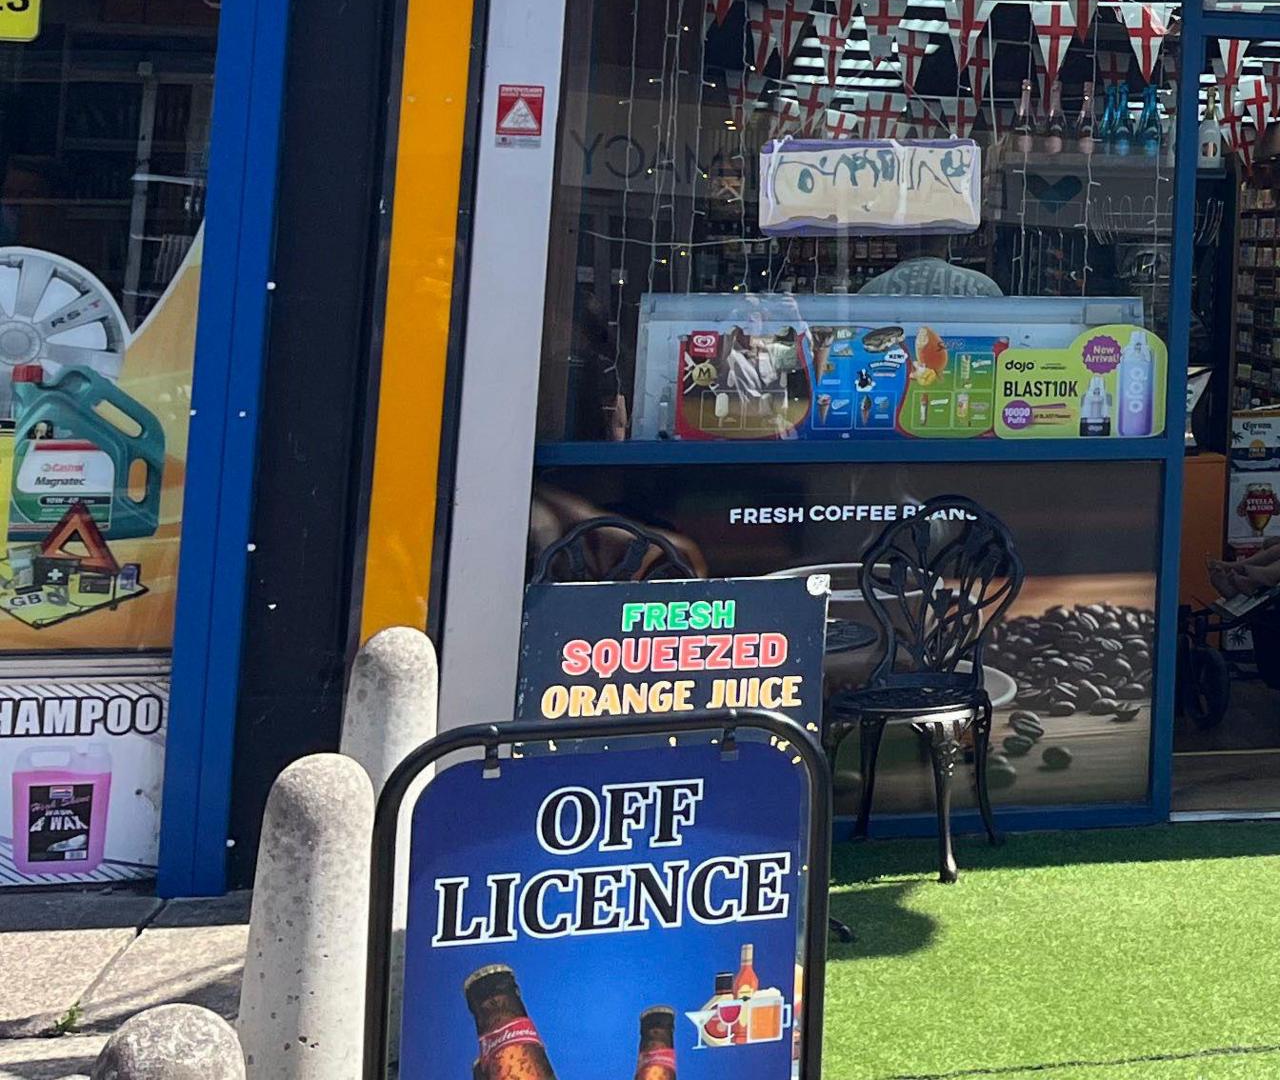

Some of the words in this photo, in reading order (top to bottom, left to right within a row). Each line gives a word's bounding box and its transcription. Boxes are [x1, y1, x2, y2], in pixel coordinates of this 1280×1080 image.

[1004, 359, 1036, 373] dojo
[1003, 380, 1079, 398] BLAST10K
[729, 506, 804, 524] FRESH
[808, 504, 898, 522] COFFEE
[10, 593, 42, 607] GB
[621, 600, 736, 633] FRESH
[562, 633, 788, 678] SQUEEZED
[541, 680, 695, 718] ORANGE
[707, 675, 803, 711] JUICE
[50, 815, 89, 831] WAX
[536, 778, 704, 855] OFF
[432, 851, 791, 947] LICENCE
